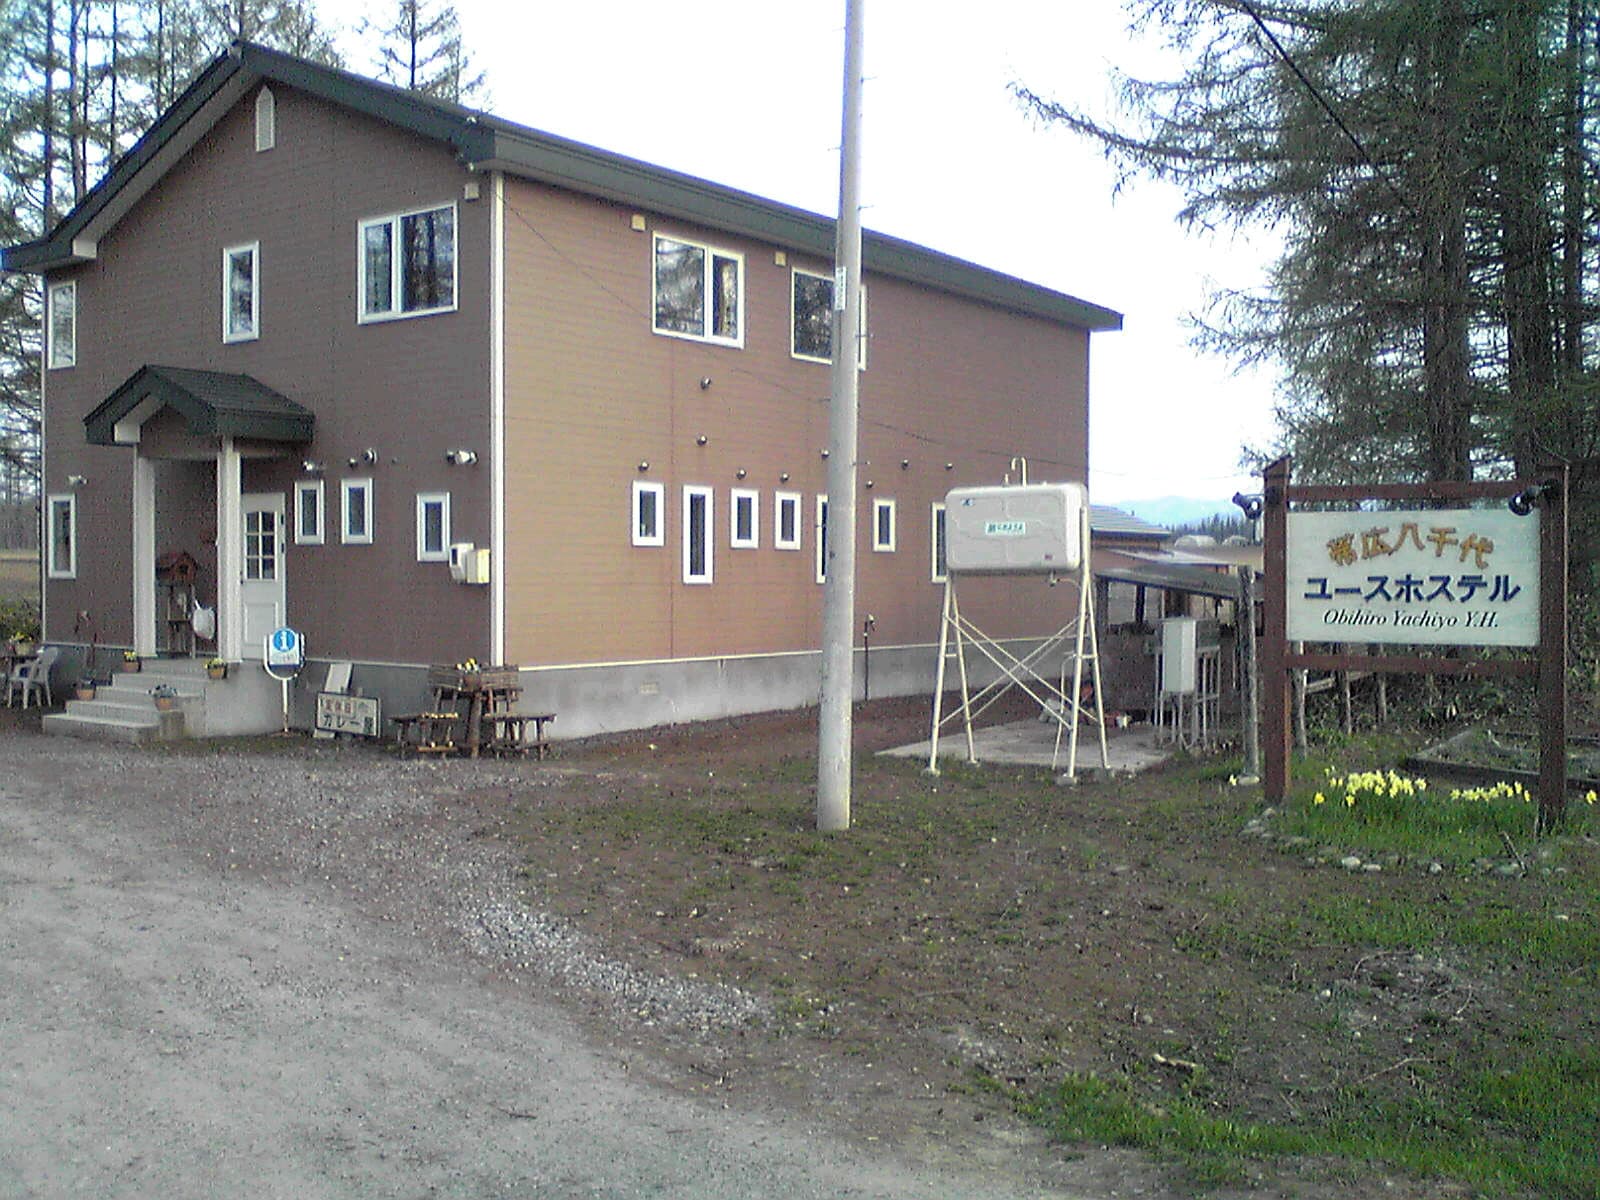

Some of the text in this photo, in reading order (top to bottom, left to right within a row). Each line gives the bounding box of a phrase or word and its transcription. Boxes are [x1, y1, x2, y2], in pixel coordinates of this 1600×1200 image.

[1326, 522, 1494, 570] 帯広八千代
[1303, 573, 1521, 603] ユースホステル
[1322, 609, 1499, 632] Obihiro Yachiyo Y.H.
